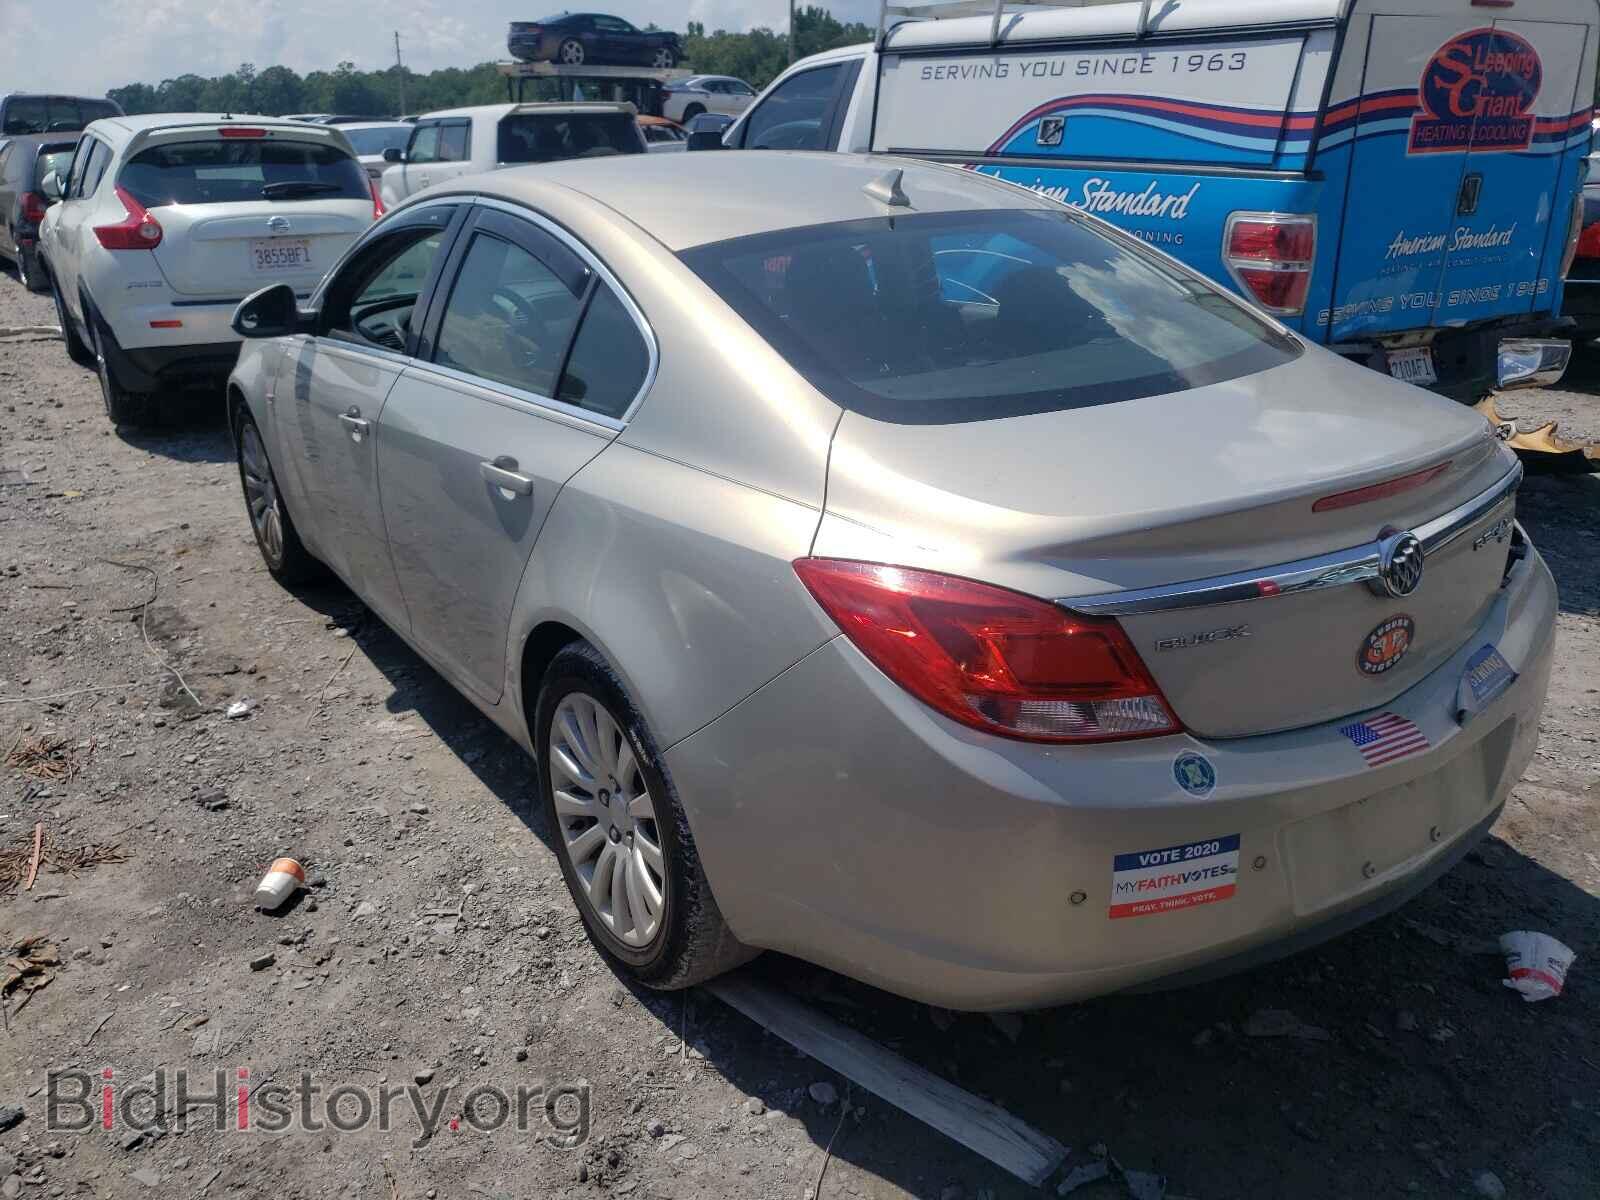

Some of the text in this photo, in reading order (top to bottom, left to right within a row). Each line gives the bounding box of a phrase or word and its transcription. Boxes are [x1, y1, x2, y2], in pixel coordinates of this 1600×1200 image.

[921, 52, 1247, 81] SERVING YOU SINCE 1963
[1448, 74, 1523, 119] Giant
[1417, 124, 1466, 142] HEATING
[1480, 123, 1527, 141] COOLING
[1073, 178, 1200, 219] Standard
[1385, 221, 1518, 259] American Standard
[255, 247, 312, 264] 3855BF1
[1400, 293, 1441, 310] YOU
[1448, 284, 1501, 306] SINCE
[1153, 624, 1254, 650] BUICK
[1139, 841, 1220, 866] VOTE 2020
